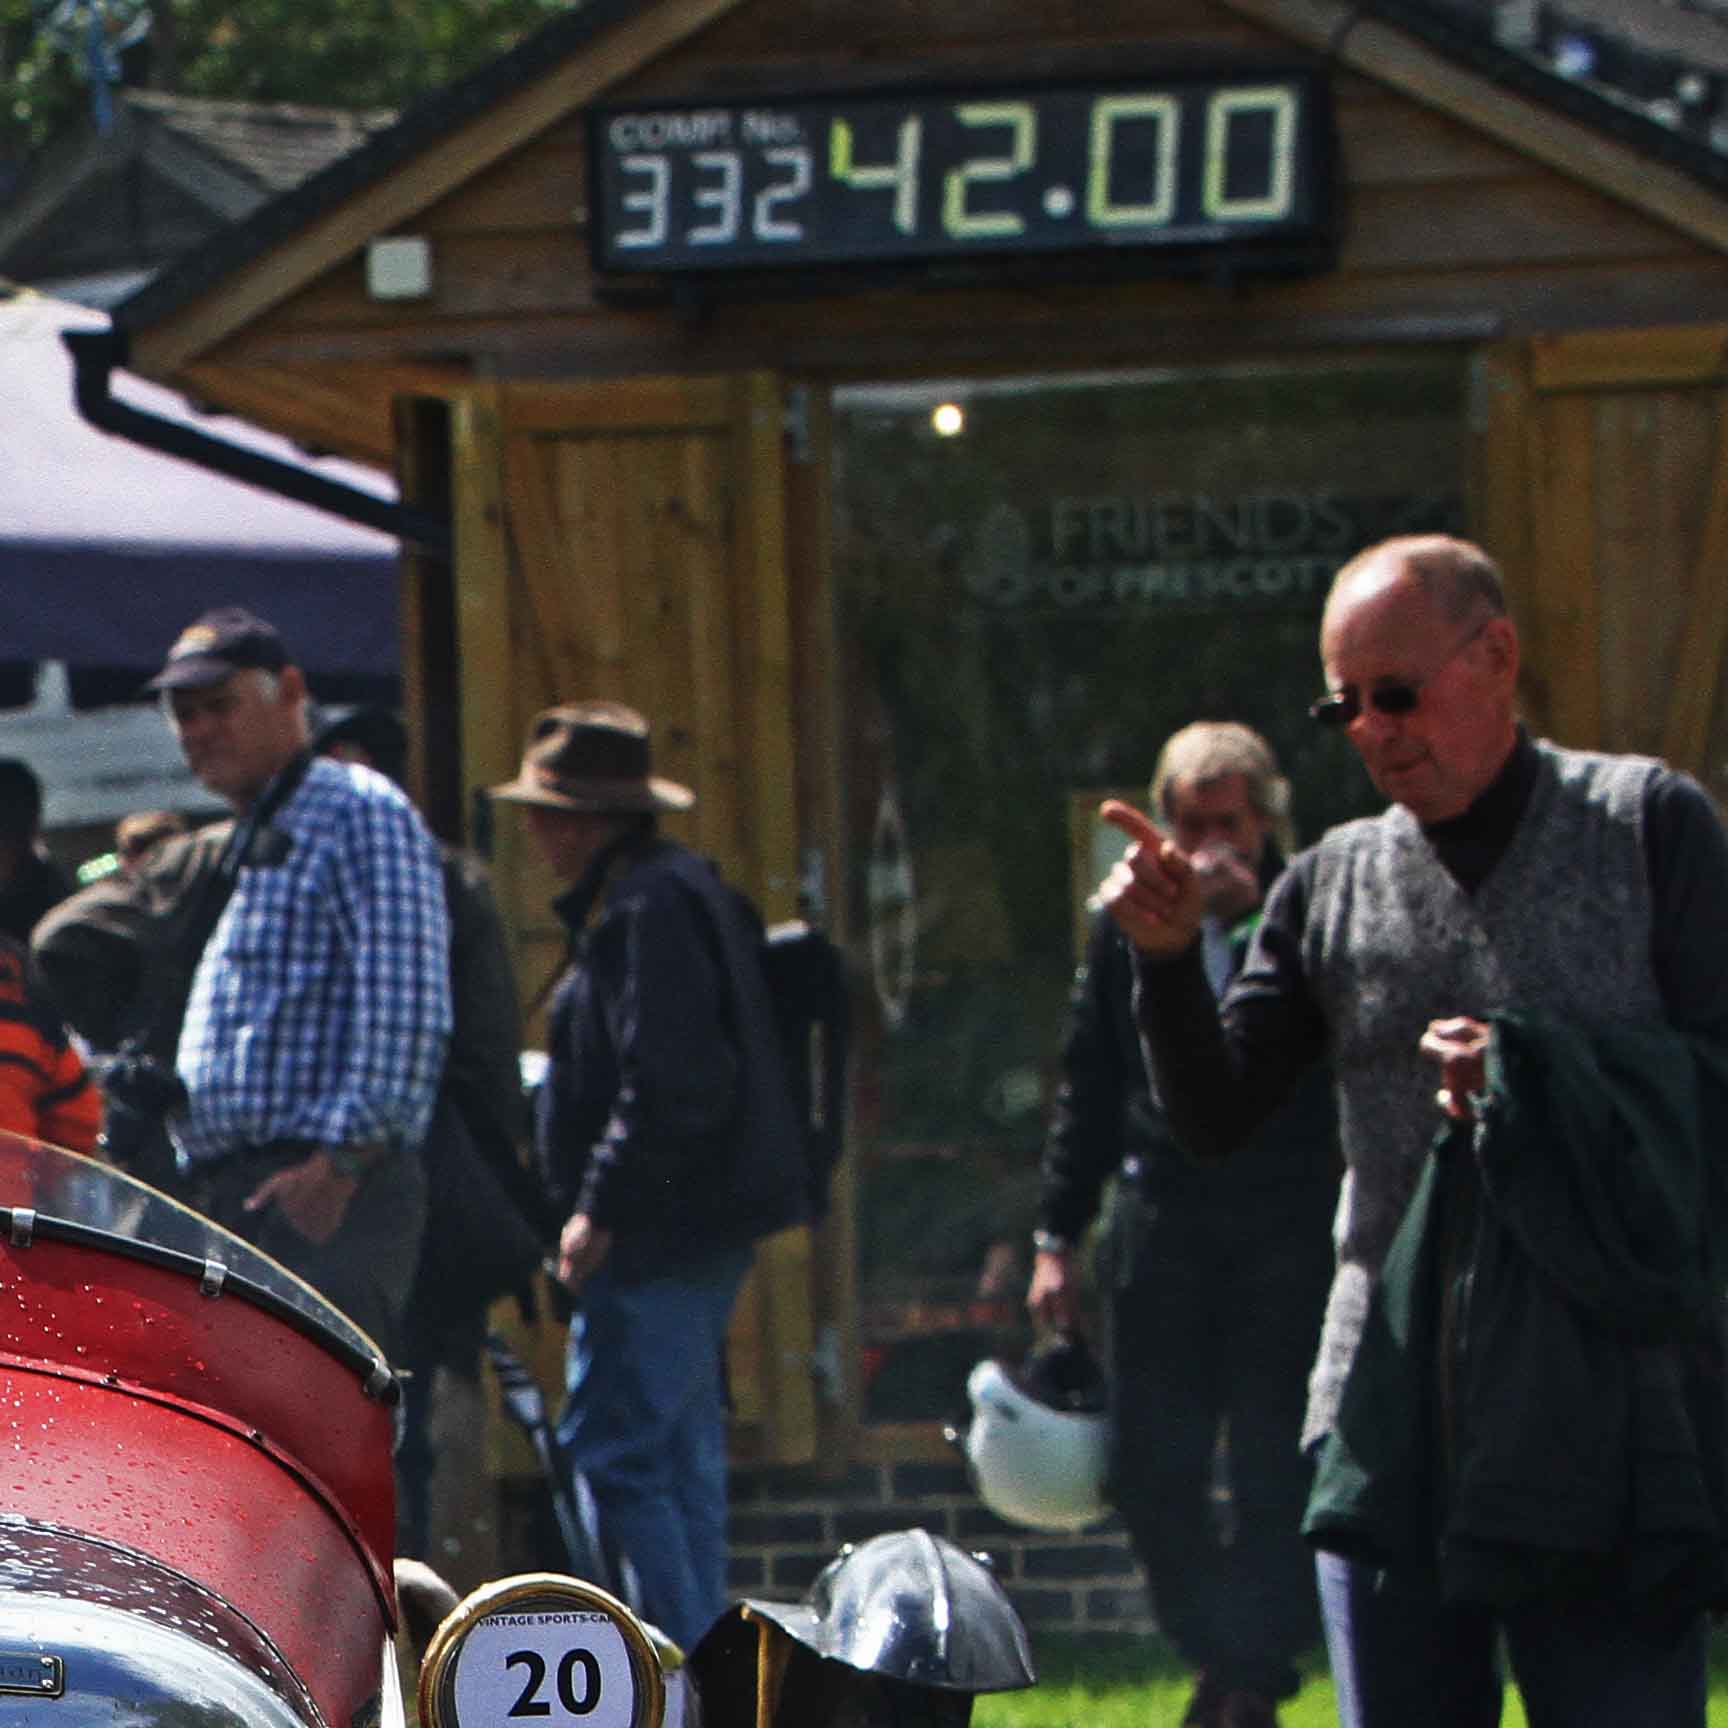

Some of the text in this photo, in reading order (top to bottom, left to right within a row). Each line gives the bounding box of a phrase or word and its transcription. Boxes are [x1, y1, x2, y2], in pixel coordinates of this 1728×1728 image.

[614, 150, 812, 249] 332
[830, 87, 1300, 240] 42.00
[1051, 494, 1355, 551] FRIENDS
[505, 1648, 602, 1717] 20
